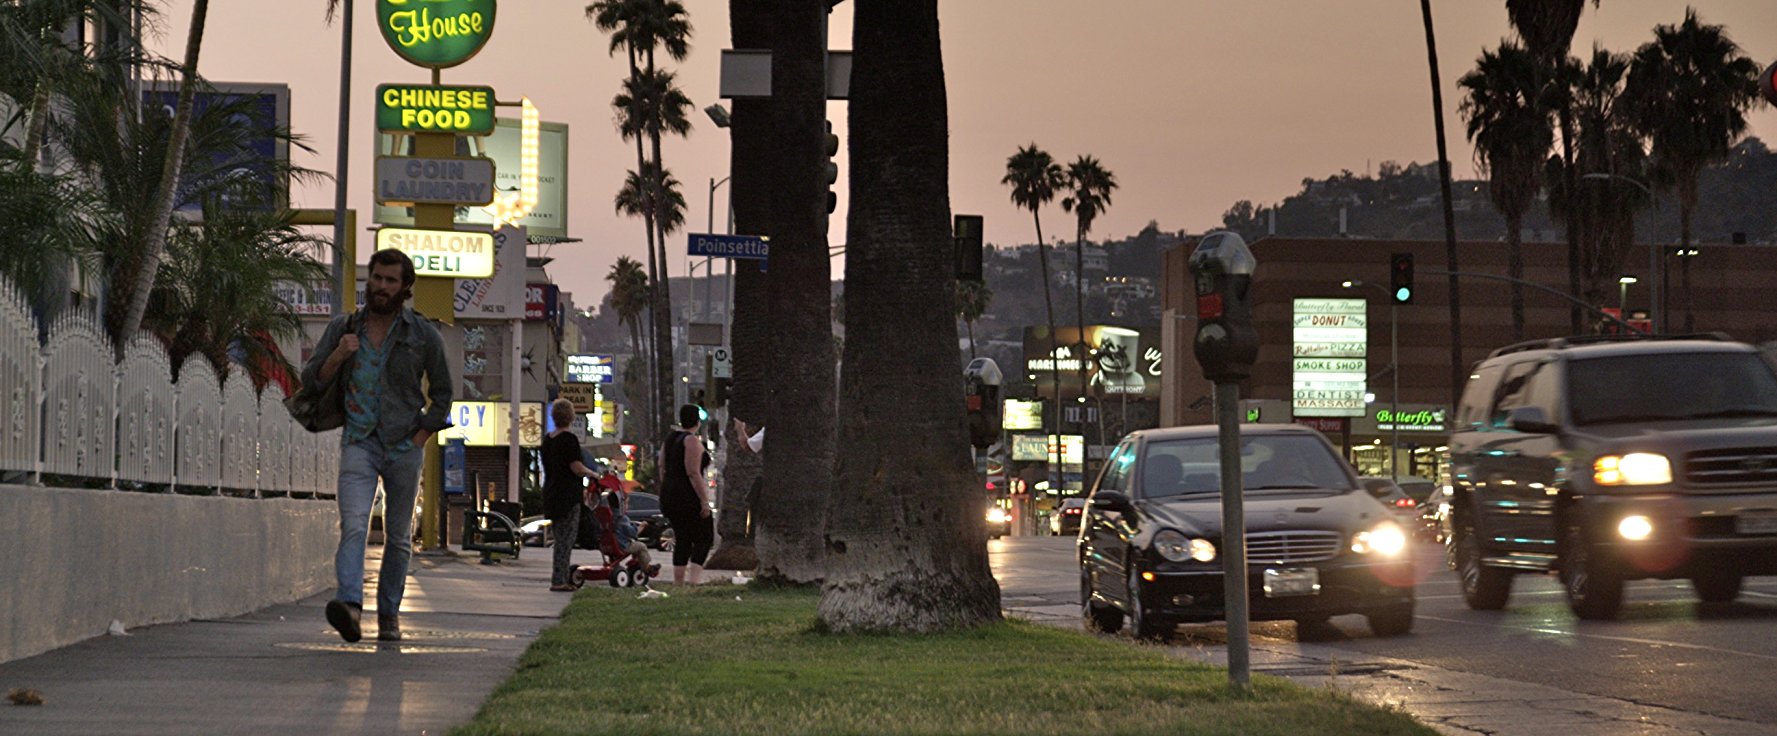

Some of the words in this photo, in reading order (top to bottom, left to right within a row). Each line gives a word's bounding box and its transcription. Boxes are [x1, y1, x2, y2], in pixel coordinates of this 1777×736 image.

[389, 7, 483, 47] House
[383, 88, 488, 109] CHINESE
[401, 109, 472, 128] FOOD
[405, 159, 464, 180] COIN
[382, 180, 486, 201] LAUNDRY
[388, 233, 484, 254] SHALOM
[697, 237, 769, 255] Poinsettia
[412, 254, 461, 272] DELI
[1312, 315, 1346, 326] DONUT
[1330, 342, 1364, 351] PIZZA
[568, 365, 612, 375] BARBER
[1296, 361, 1332, 370] SMOKE
[1336, 361, 1363, 370] SHOP
[576, 374, 603, 382] SHOP
[559, 386, 581, 394] PARK
[1296, 390, 1362, 400] DENTIST
[1297, 399, 1362, 407] MASSAGE
[1376, 409, 1433, 426] Butterfly
